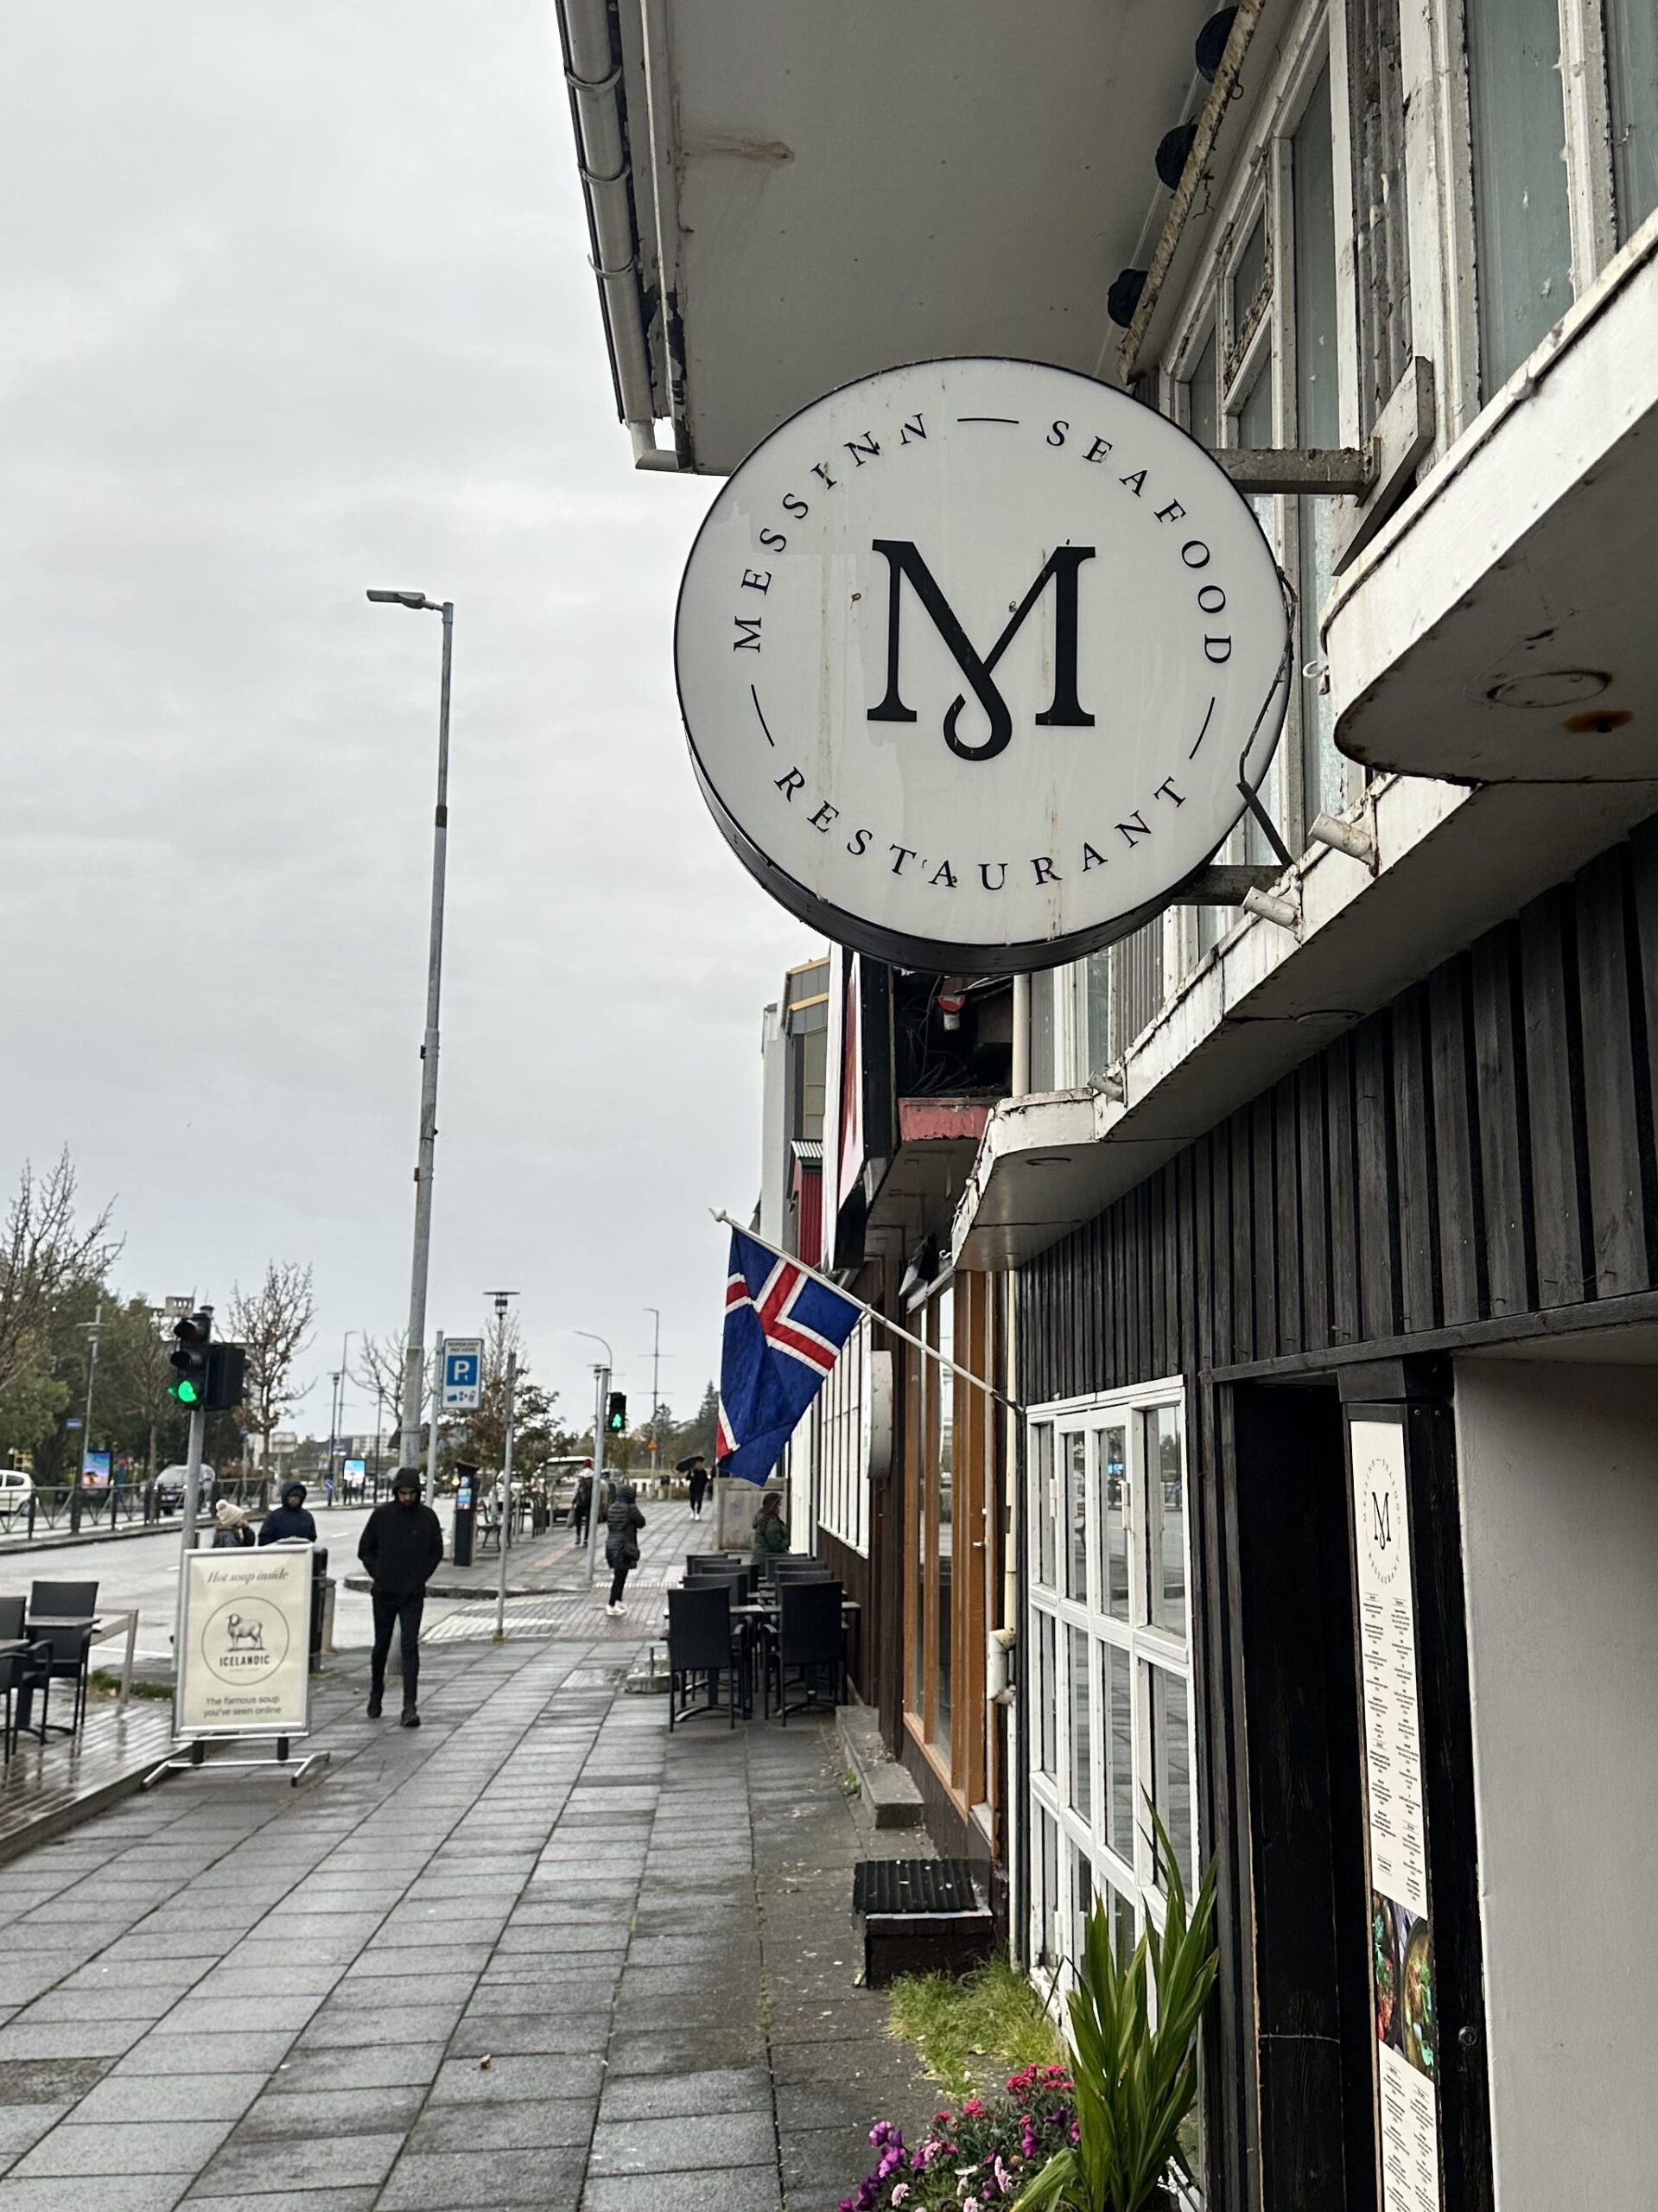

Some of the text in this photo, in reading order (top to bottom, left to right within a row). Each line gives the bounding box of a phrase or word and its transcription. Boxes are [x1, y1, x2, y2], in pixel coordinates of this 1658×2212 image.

[733, 411, 1233, 892] MESSINN SEAFOOD RESTAURANT
[867, 537, 1096, 762] M
[207, 1568, 289, 1585] Hot soup inside
[219, 1655, 270, 1667] ICELANDIC
[224, 1695, 257, 1705] famous
[258, 1695, 280, 1705] soup
[203, 1708, 232, 1718] you've
[255, 1706, 282, 1714] online
